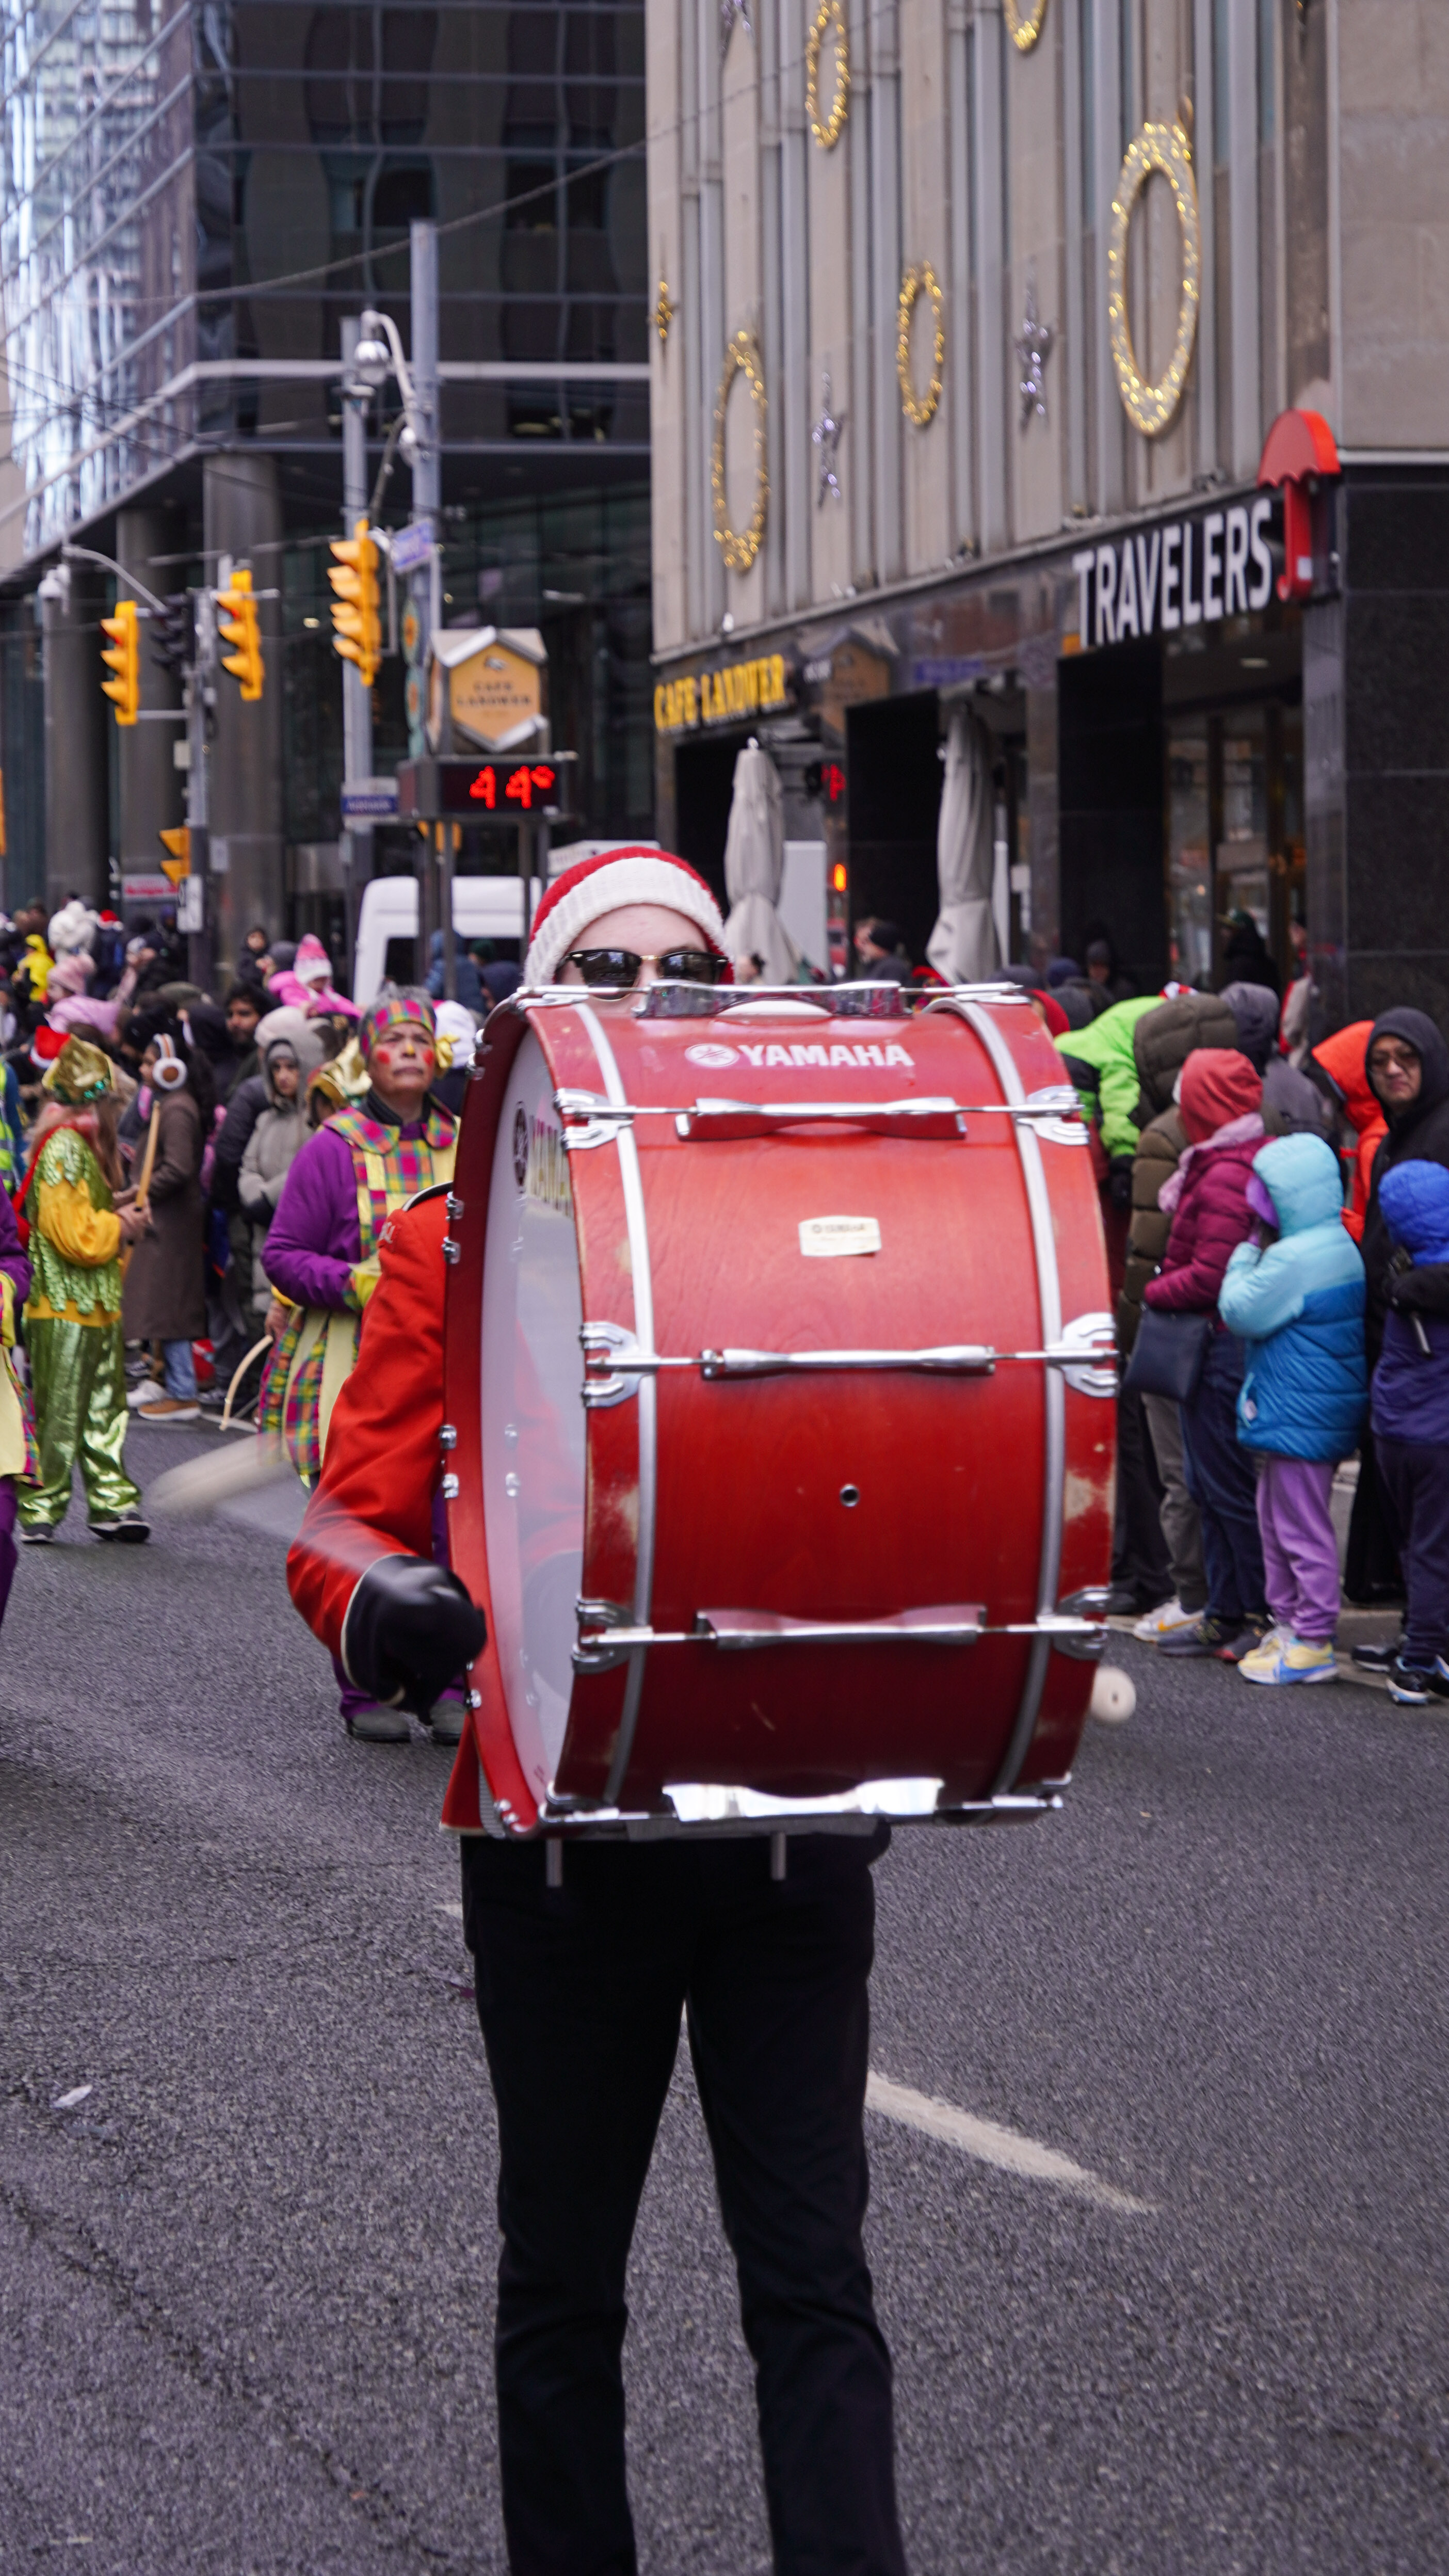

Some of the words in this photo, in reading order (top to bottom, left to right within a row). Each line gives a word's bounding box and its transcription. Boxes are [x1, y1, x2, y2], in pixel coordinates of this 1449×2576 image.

[1072, 498, 1272, 649] TRAVELERS
[654, 676, 697, 732] CAFE
[701, 653, 786, 721] LANDWER
[737, 1044, 915, 1066] YAMAHA
